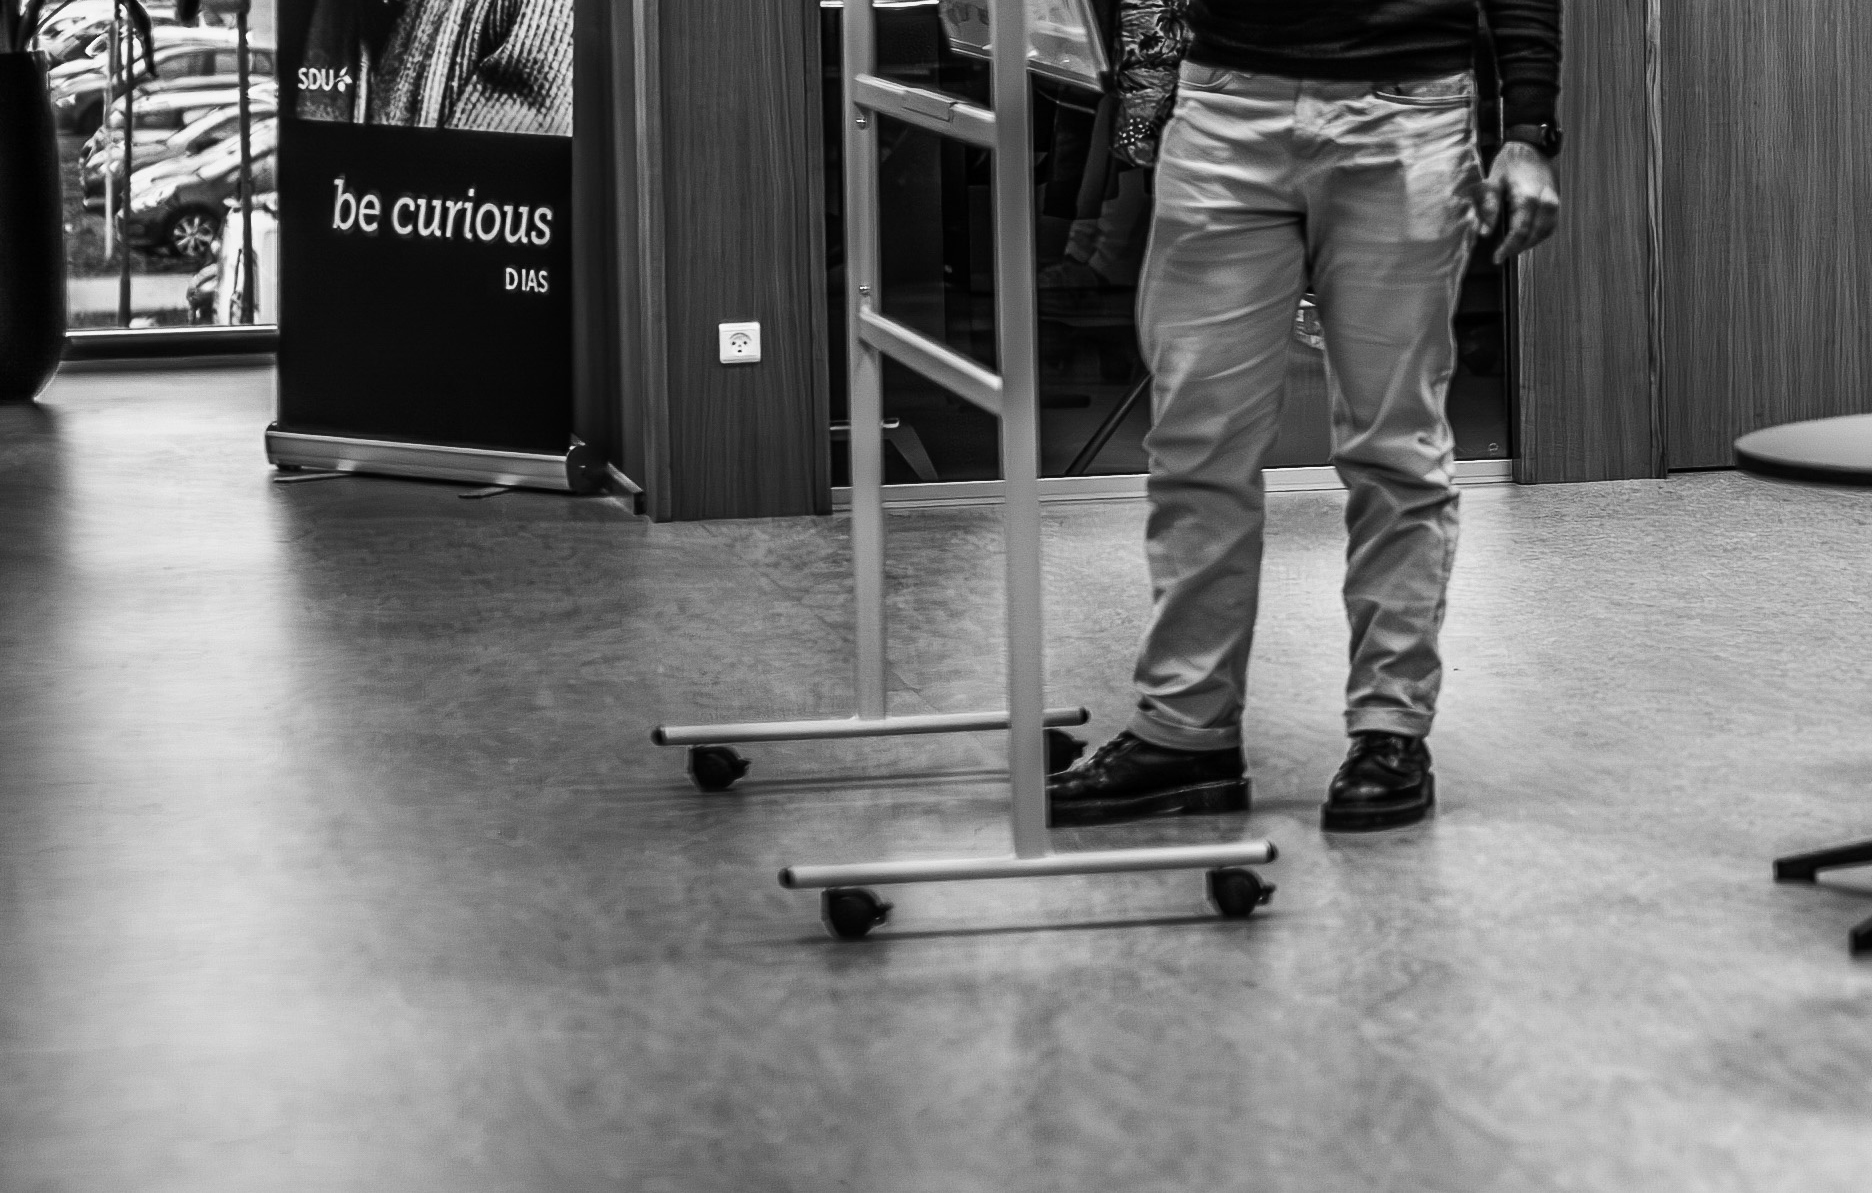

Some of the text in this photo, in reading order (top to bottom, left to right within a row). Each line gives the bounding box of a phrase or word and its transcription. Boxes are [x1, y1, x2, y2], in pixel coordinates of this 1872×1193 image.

[298, 68, 334, 91] SDU
[332, 178, 553, 245] be curious
